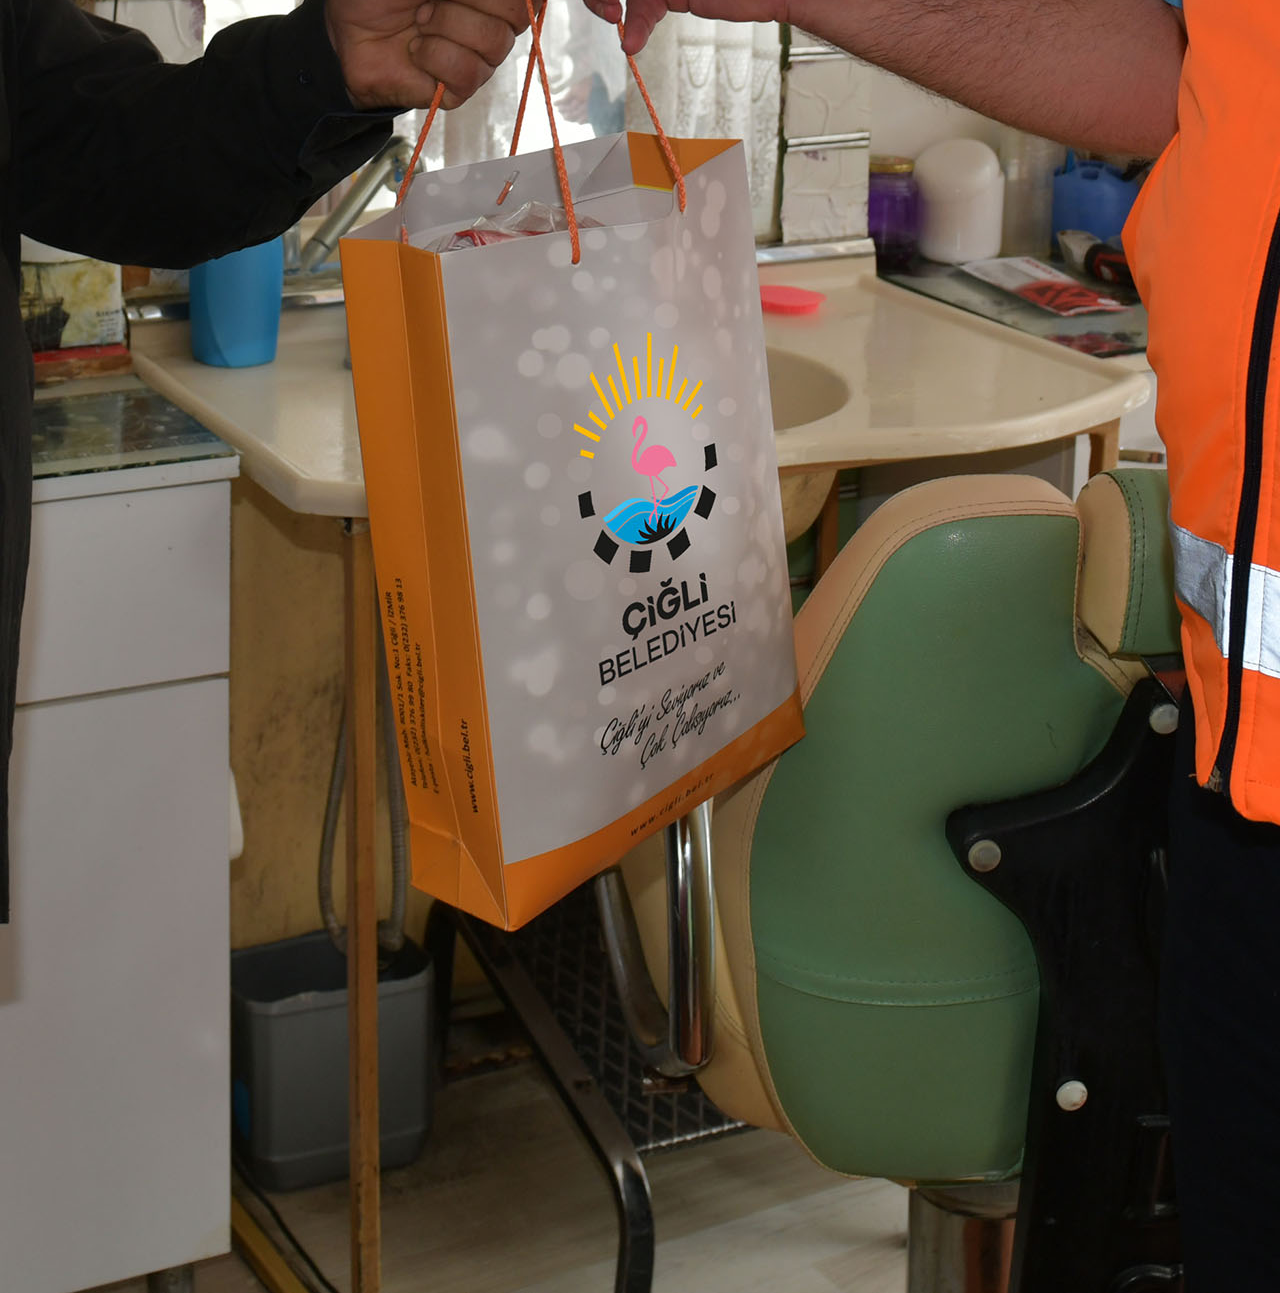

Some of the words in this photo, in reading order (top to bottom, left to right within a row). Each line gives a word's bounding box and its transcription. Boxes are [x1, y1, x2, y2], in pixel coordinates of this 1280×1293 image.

[399, 604, 407, 621] 376
[401, 623, 411, 653] 0(232)
[622, 572, 709, 641] ÇİĞLİ
[598, 600, 737, 686] BELEDİYESİ
[656, 672, 711, 718] Seviyoruz
[712, 661, 726, 681] ve
[461, 718, 479, 814] www.cigli.bel.tr
[630, 772, 715, 837] www.cigli.bel.tr
